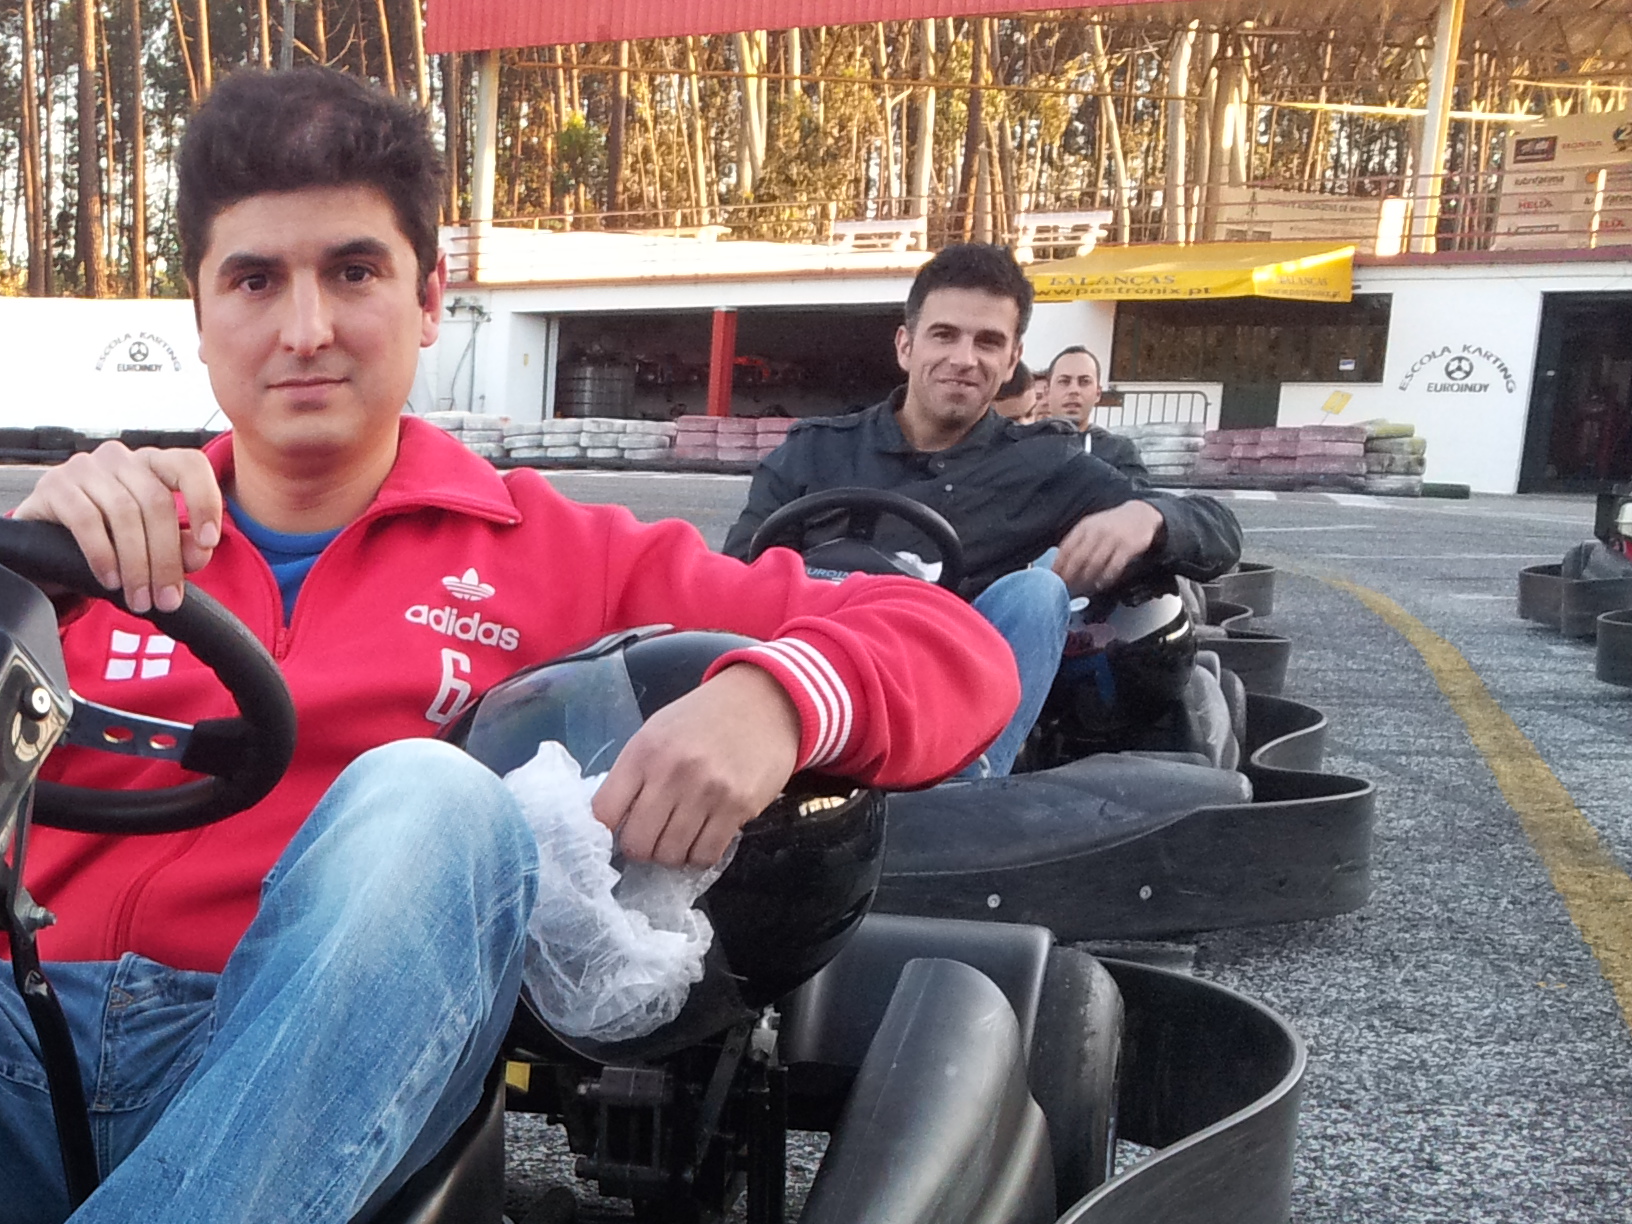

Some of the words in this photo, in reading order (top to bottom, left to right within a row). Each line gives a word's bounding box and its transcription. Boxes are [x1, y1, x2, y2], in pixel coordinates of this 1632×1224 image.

[95, 333, 132, 371] ESCOLA
[139, 331, 182, 372] KARTING
[117, 363, 163, 372] EUROINDY
[1398, 346, 1452, 392] ESCOLA
[1462, 344, 1517, 394] KARTING
[1426, 382, 1490, 393] EUROINDY
[404, 604, 520, 651] adidas
[424, 647, 472, 726] 6
